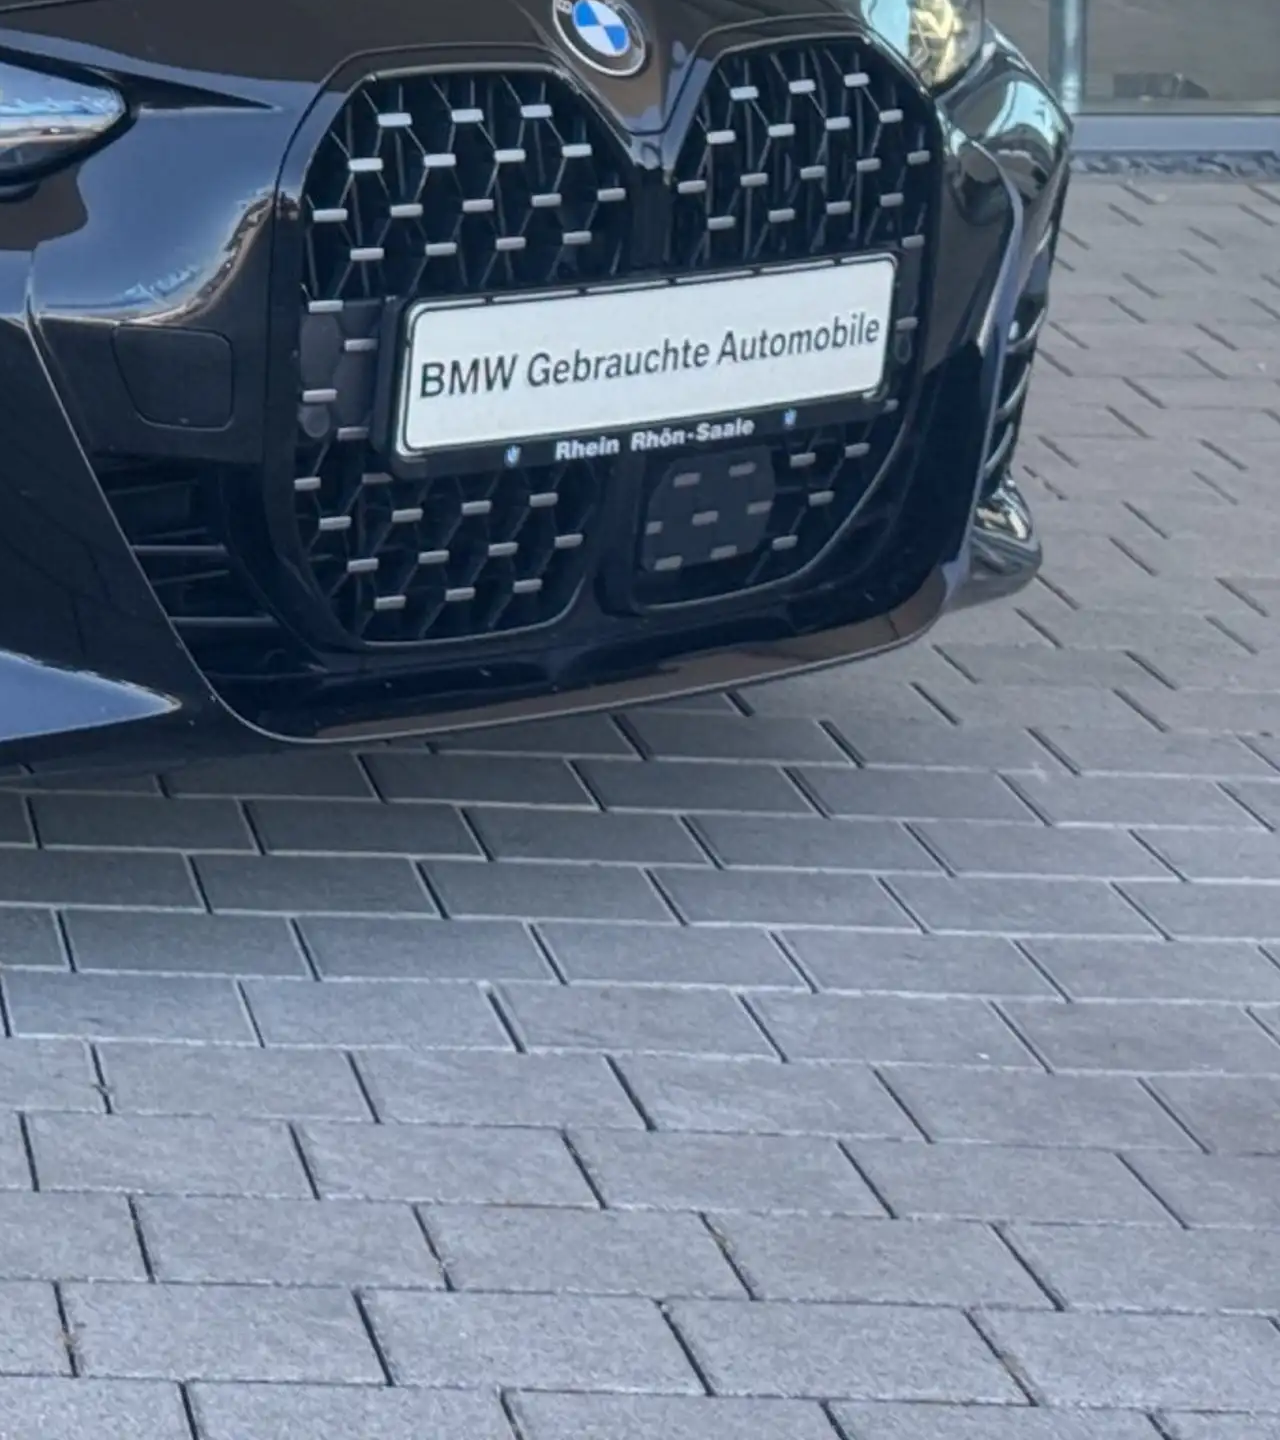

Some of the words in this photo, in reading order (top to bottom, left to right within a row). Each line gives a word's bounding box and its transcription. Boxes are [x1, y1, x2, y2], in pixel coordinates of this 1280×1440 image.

[420, 354, 519, 398] BMW
[526, 338, 709, 388] Gebrauchte
[716, 312, 880, 366] Automobile
[555, 436, 620, 460] Rhein
